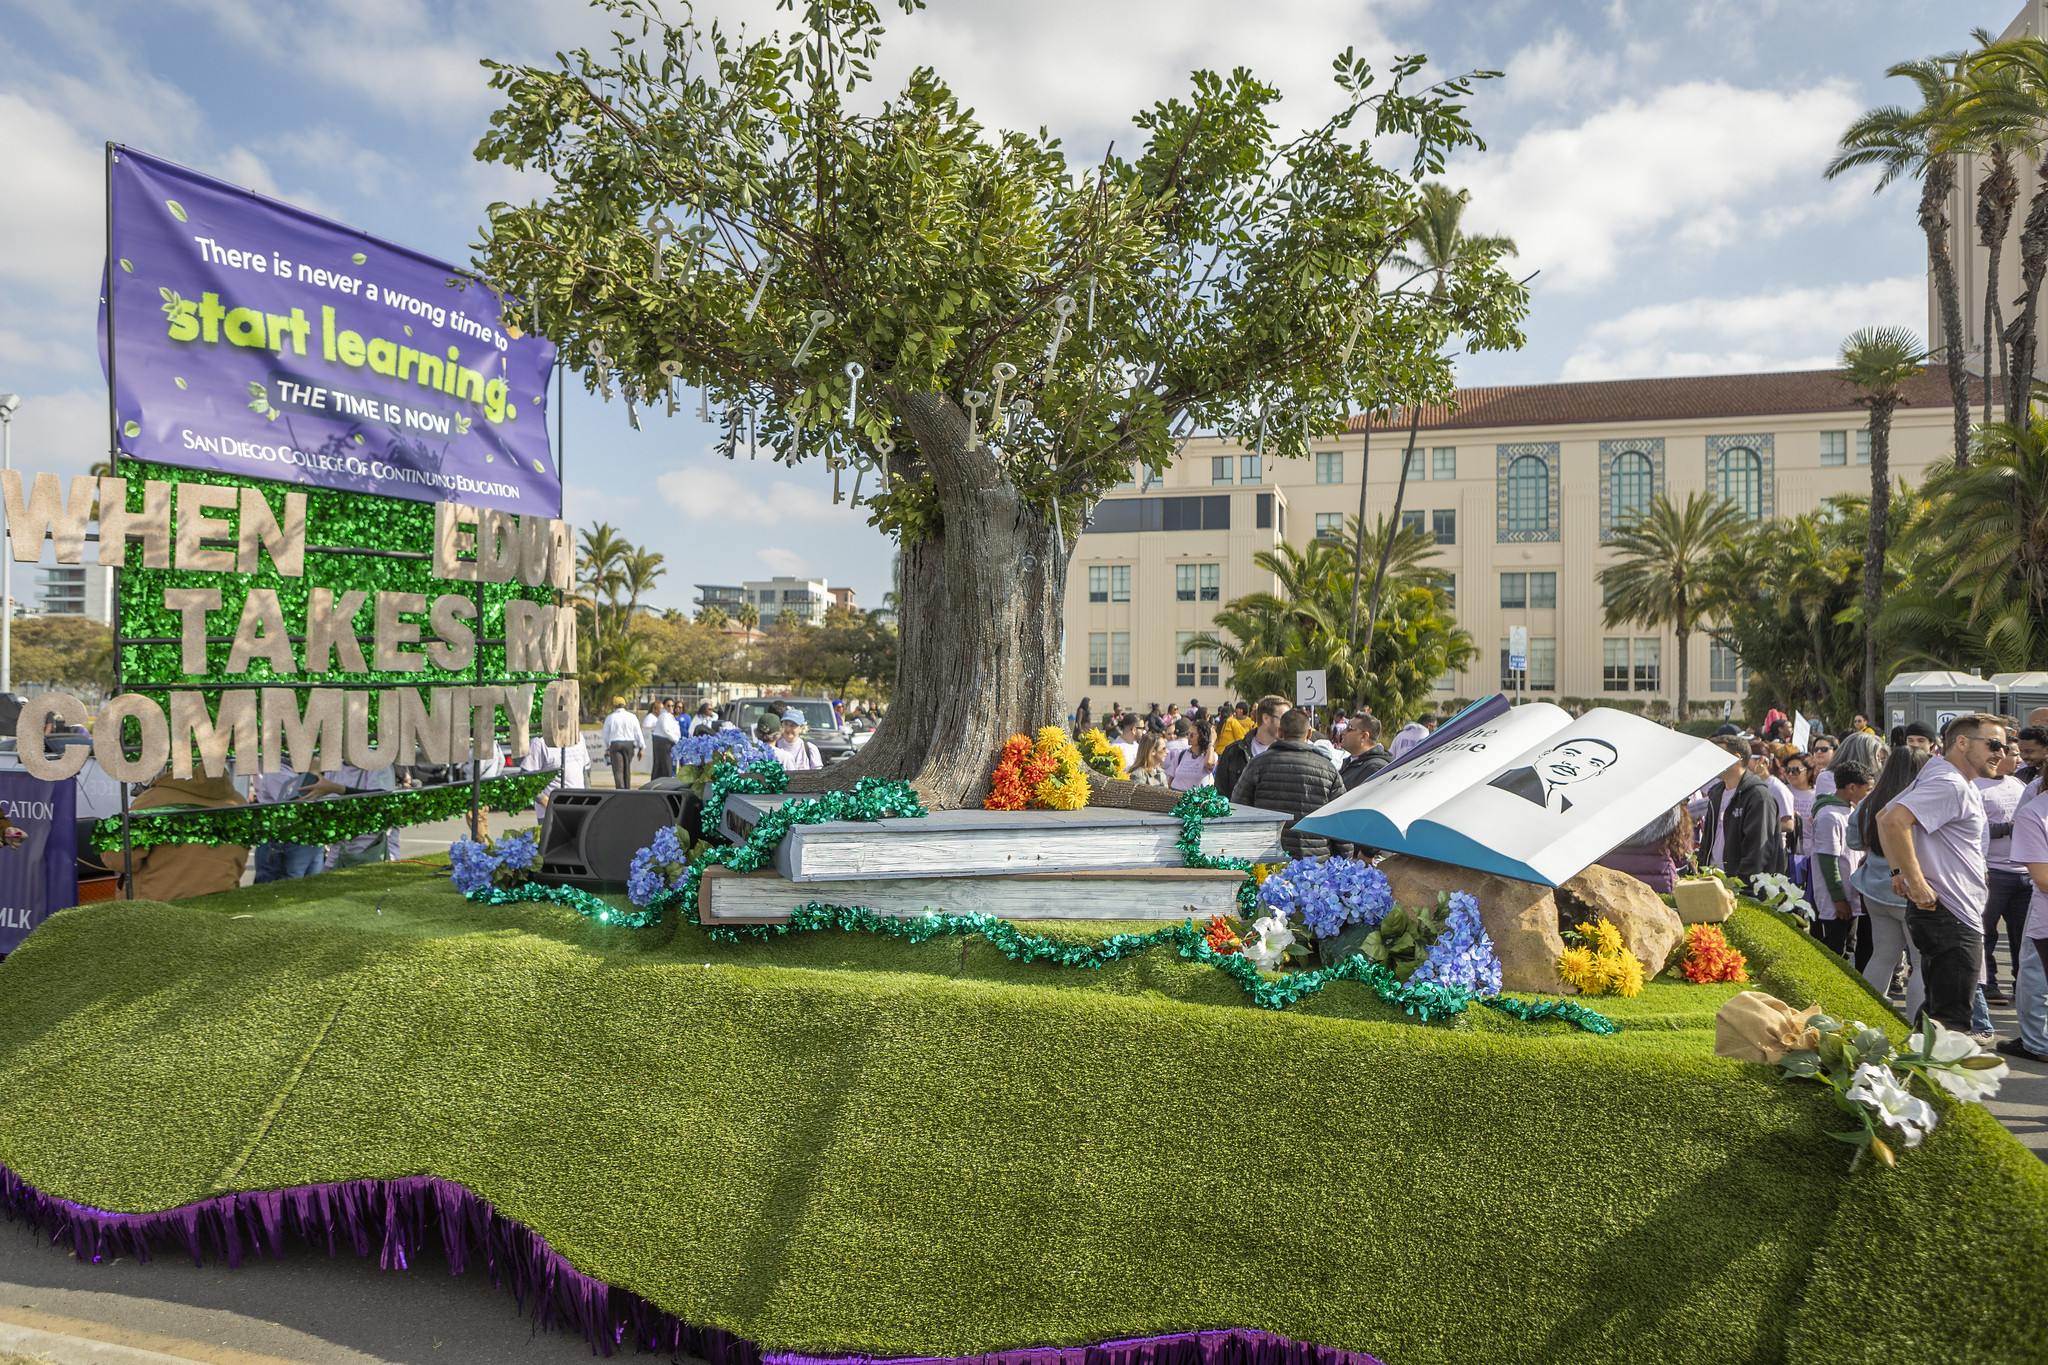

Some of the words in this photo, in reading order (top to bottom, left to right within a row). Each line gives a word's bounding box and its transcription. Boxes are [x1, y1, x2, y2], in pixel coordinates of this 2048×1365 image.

[194, 236, 267, 273] There
[273, 251, 292, 278] is
[298, 263, 362, 296] never
[366, 283, 378, 301] a
[383, 288, 446, 328] wrong
[450, 310, 492, 343] time
[494, 330, 508, 351] to
[168, 291, 311, 355] start
[322, 305, 517, 423] learning.
[277, 380, 327, 409] THE
[331, 391, 378, 420] TIME
[384, 403, 401, 424] IS
[405, 408, 450, 434] NOW
[0, 470, 307, 577] WHEN
[164, 588, 478, 675] TAKES
[16, 686, 536, 782] COMMUNITY
[1304, 676, 1317, 700] 3
